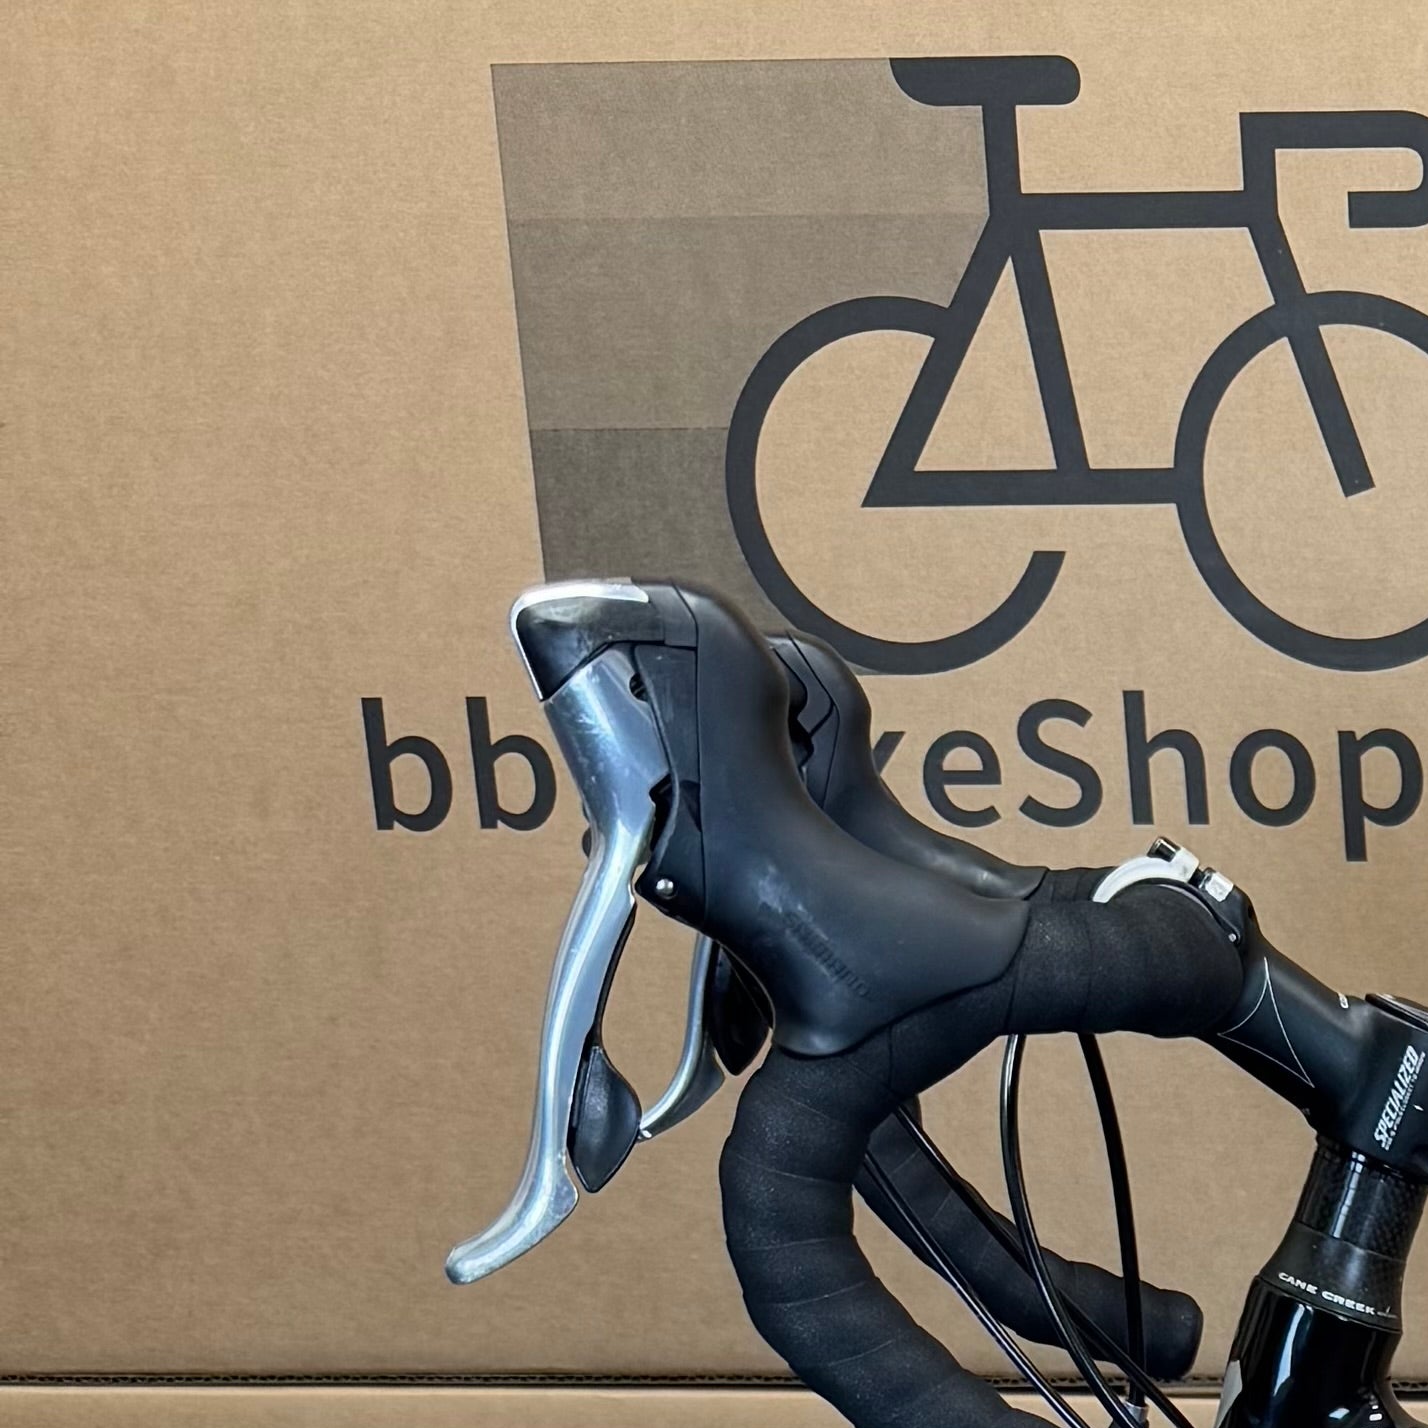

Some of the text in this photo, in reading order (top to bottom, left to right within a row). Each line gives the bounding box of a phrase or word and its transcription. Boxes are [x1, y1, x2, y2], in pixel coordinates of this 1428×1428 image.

[1374, 1045, 1419, 1149] SPECIALIZED
[1278, 1272, 1318, 1295] CANE
[1321, 1290, 1376, 1315] CREEK
